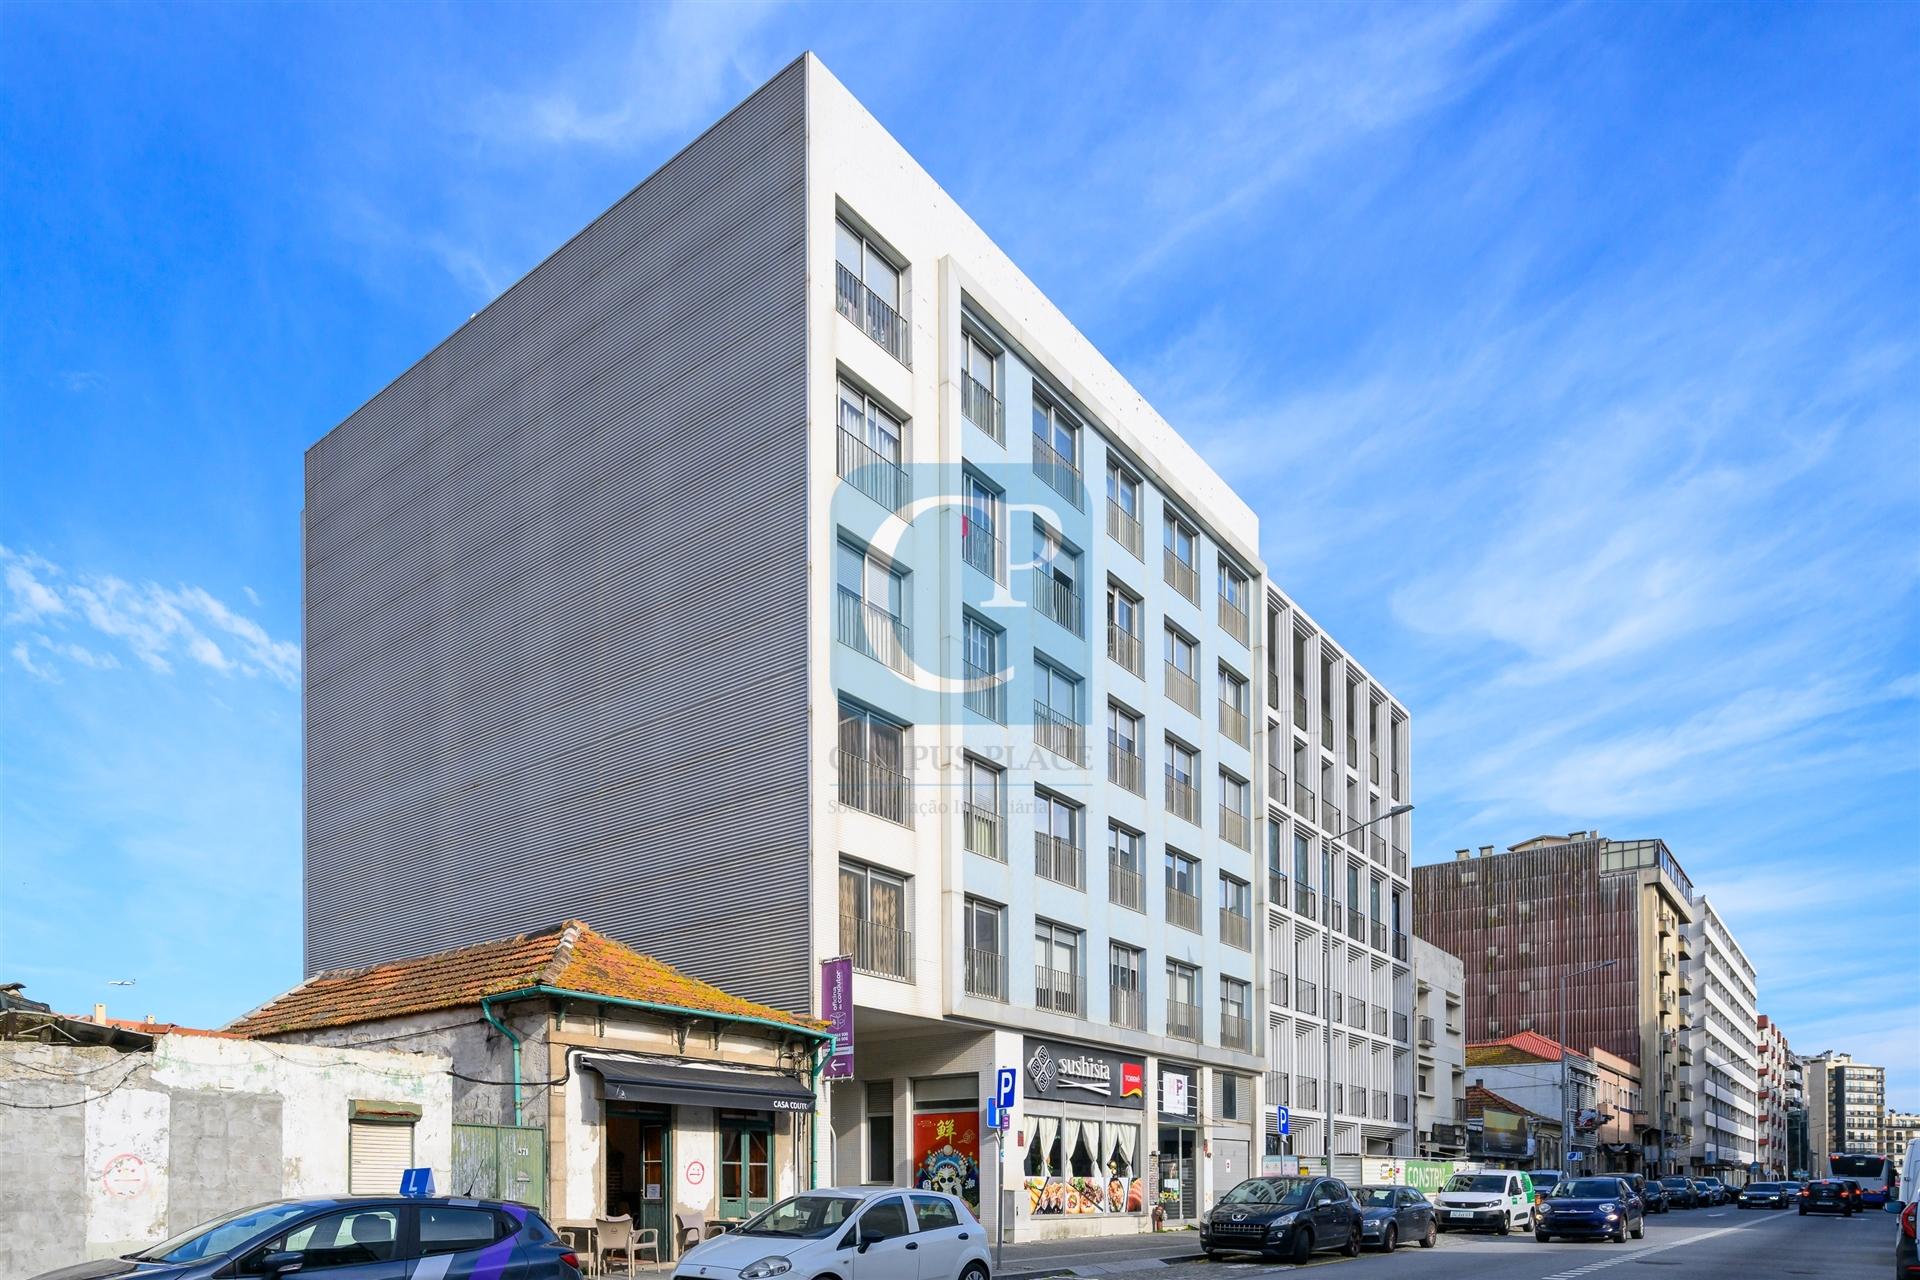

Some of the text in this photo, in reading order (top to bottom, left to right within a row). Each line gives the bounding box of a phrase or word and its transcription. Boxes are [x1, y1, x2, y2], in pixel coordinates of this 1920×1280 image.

[1058, 1056, 1110, 1080] sushisia
[1000, 1071, 1013, 1106] P
[773, 1100, 789, 1109] CASA
[1280, 1109, 1287, 1130] P
[936, 1119, 957, 1144] 鮮
[408, 1170, 418, 1192] L
